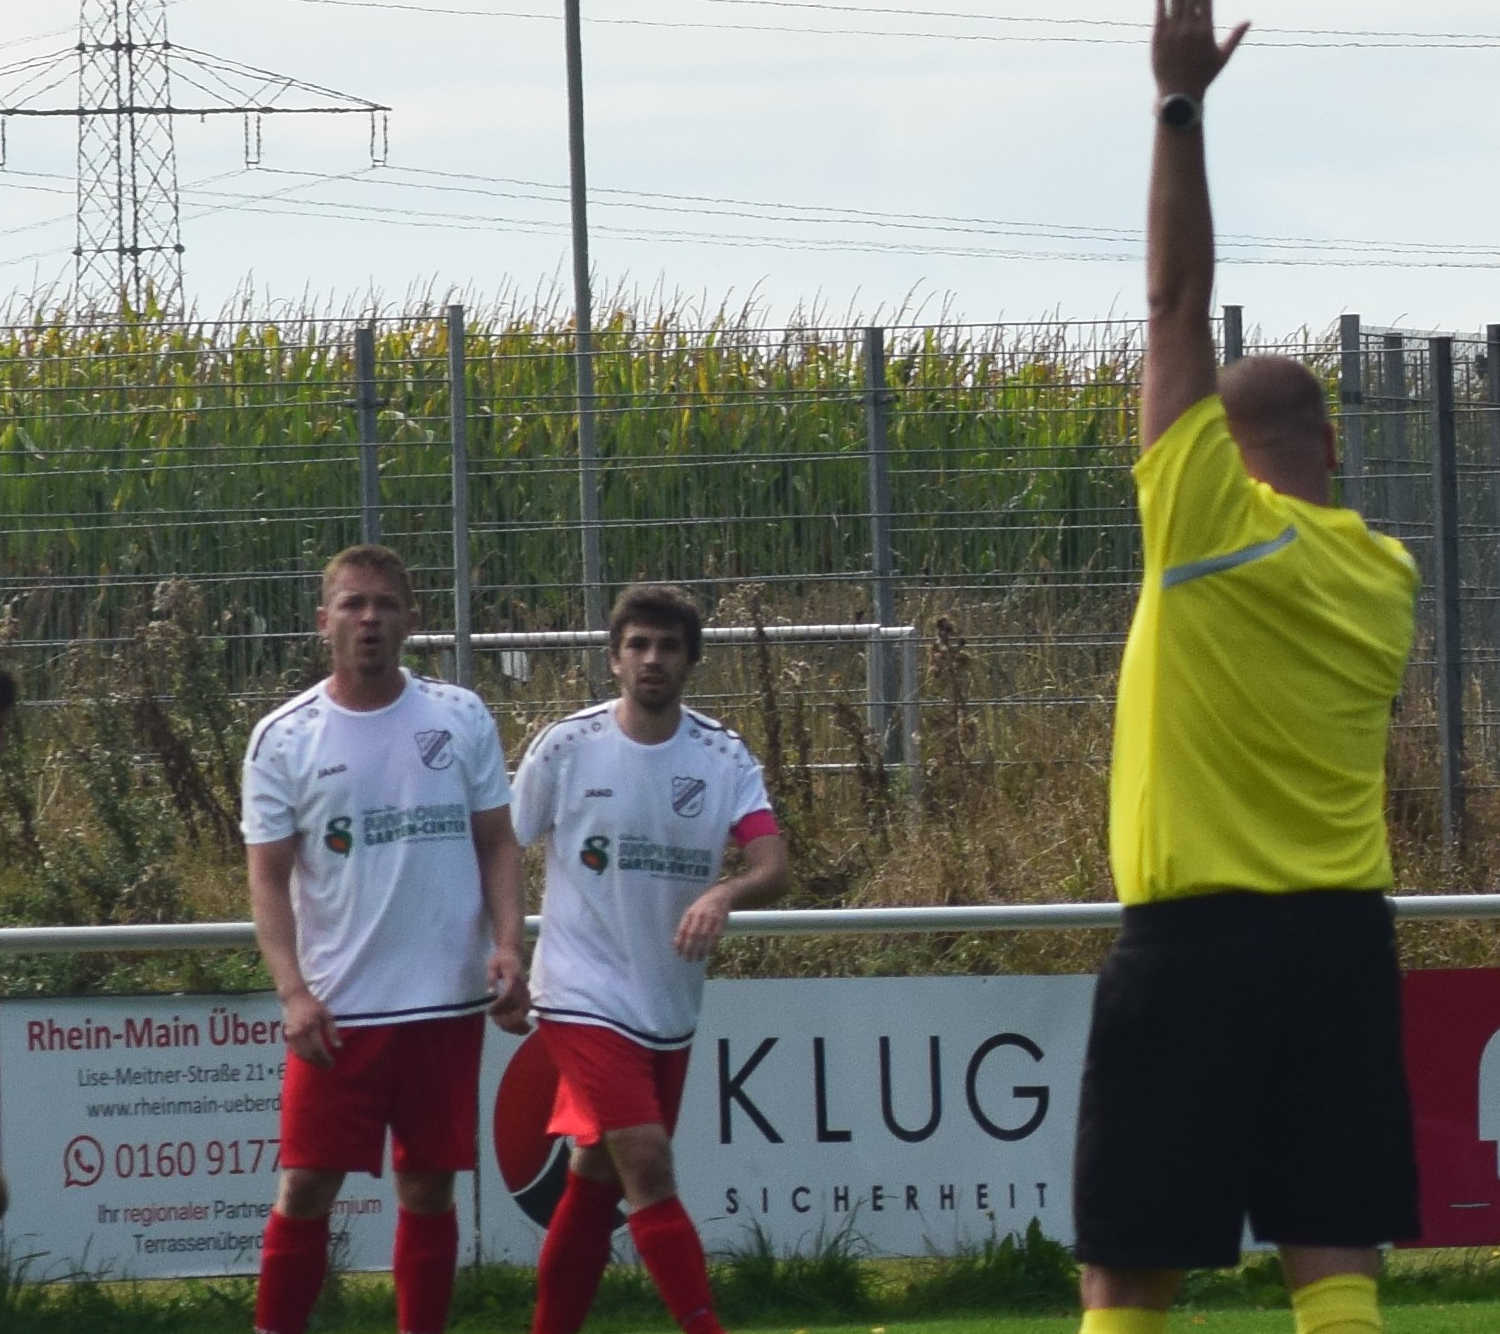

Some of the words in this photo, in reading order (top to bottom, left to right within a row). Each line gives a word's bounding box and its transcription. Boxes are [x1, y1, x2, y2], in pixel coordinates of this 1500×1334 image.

[27, 1015, 199, 1051] Rhein-Main
[209, 1007, 290, 1046] Über
[77, 1062, 241, 1087] Lise-Meitner-Straße
[715, 1032, 1051, 1145] KLUG
[86, 1094, 283, 1118] www.rheinmain-ueberd
[115, 1141, 197, 1179] 0160
[206, 1138, 283, 1176] 9177
[97, 1202, 120, 1224] Ihr
[123, 1202, 211, 1226] regionaler
[724, 1181, 1050, 1216] SICHERHEIT
